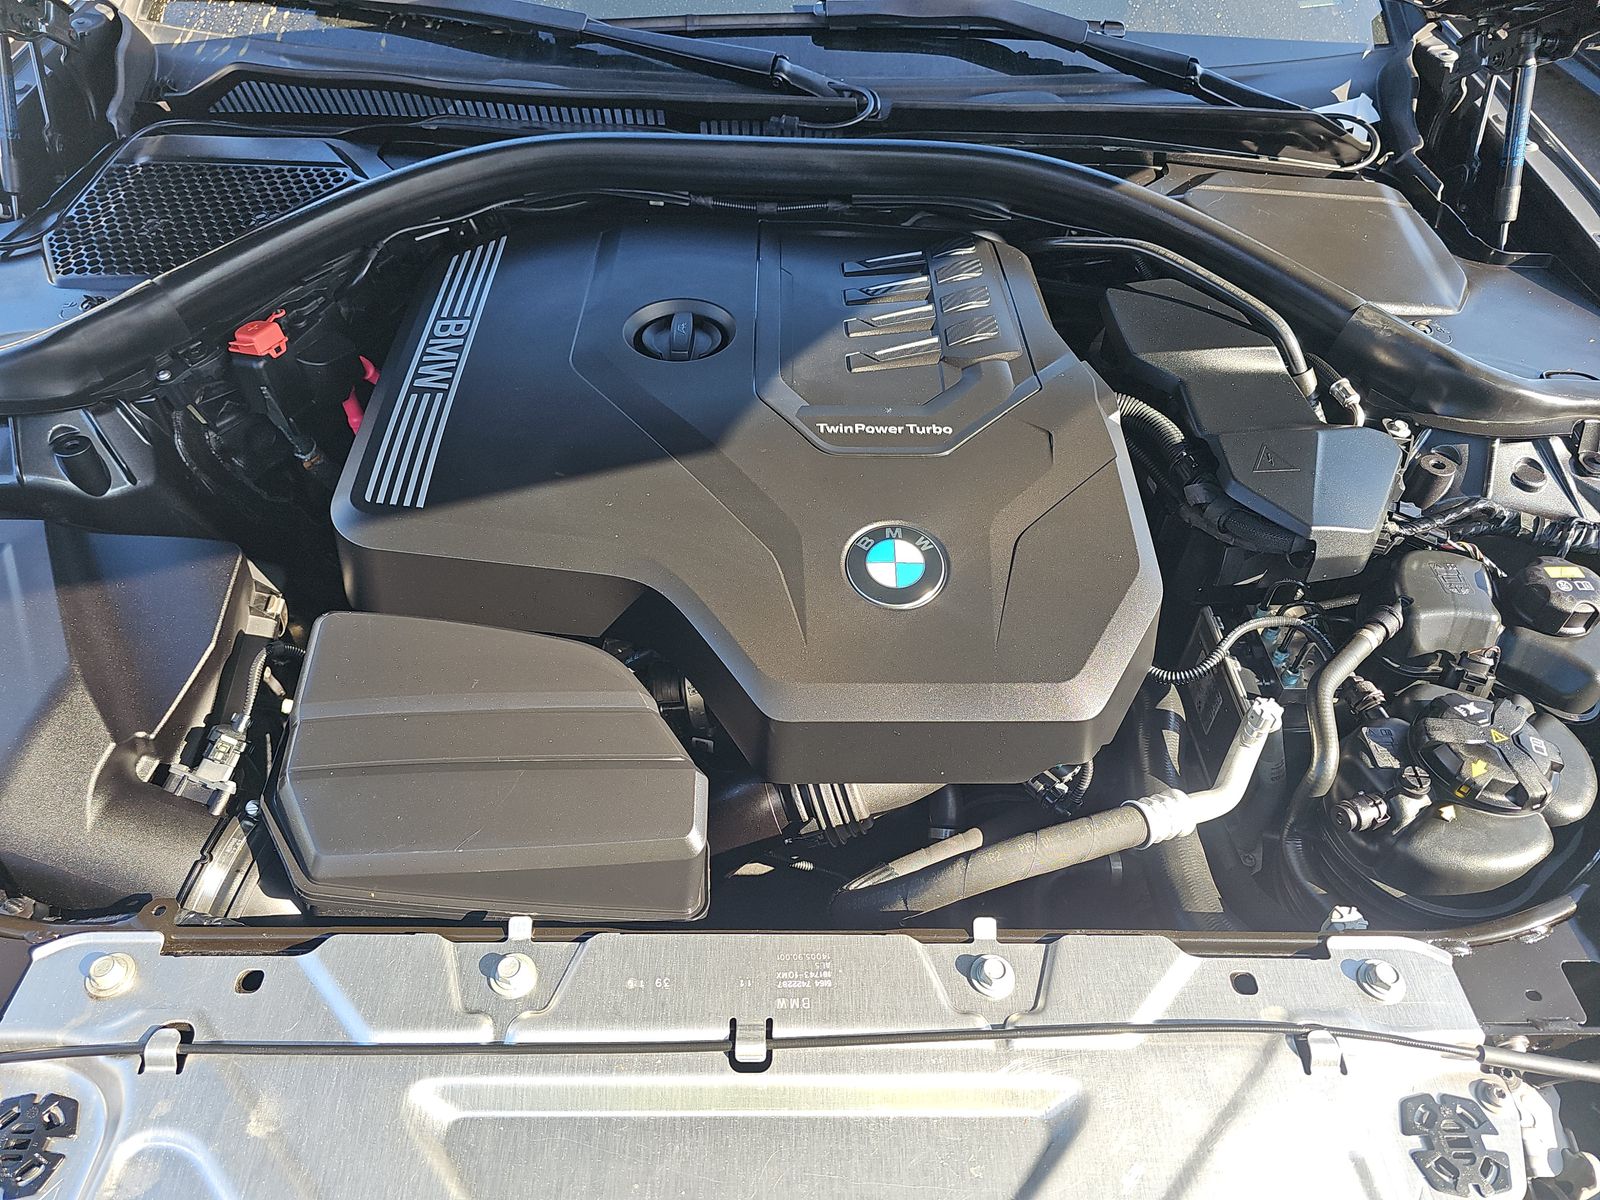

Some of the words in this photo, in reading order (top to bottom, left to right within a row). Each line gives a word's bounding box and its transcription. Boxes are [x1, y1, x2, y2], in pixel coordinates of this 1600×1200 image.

[412, 319, 471, 390] BMW
[816, 423, 904, 435] TwinPower
[906, 423, 953, 436] Turbo
[854, 527, 934, 551] BMW
[654, 977, 671, 988] 39
[776, 997, 811, 1009] BMW
